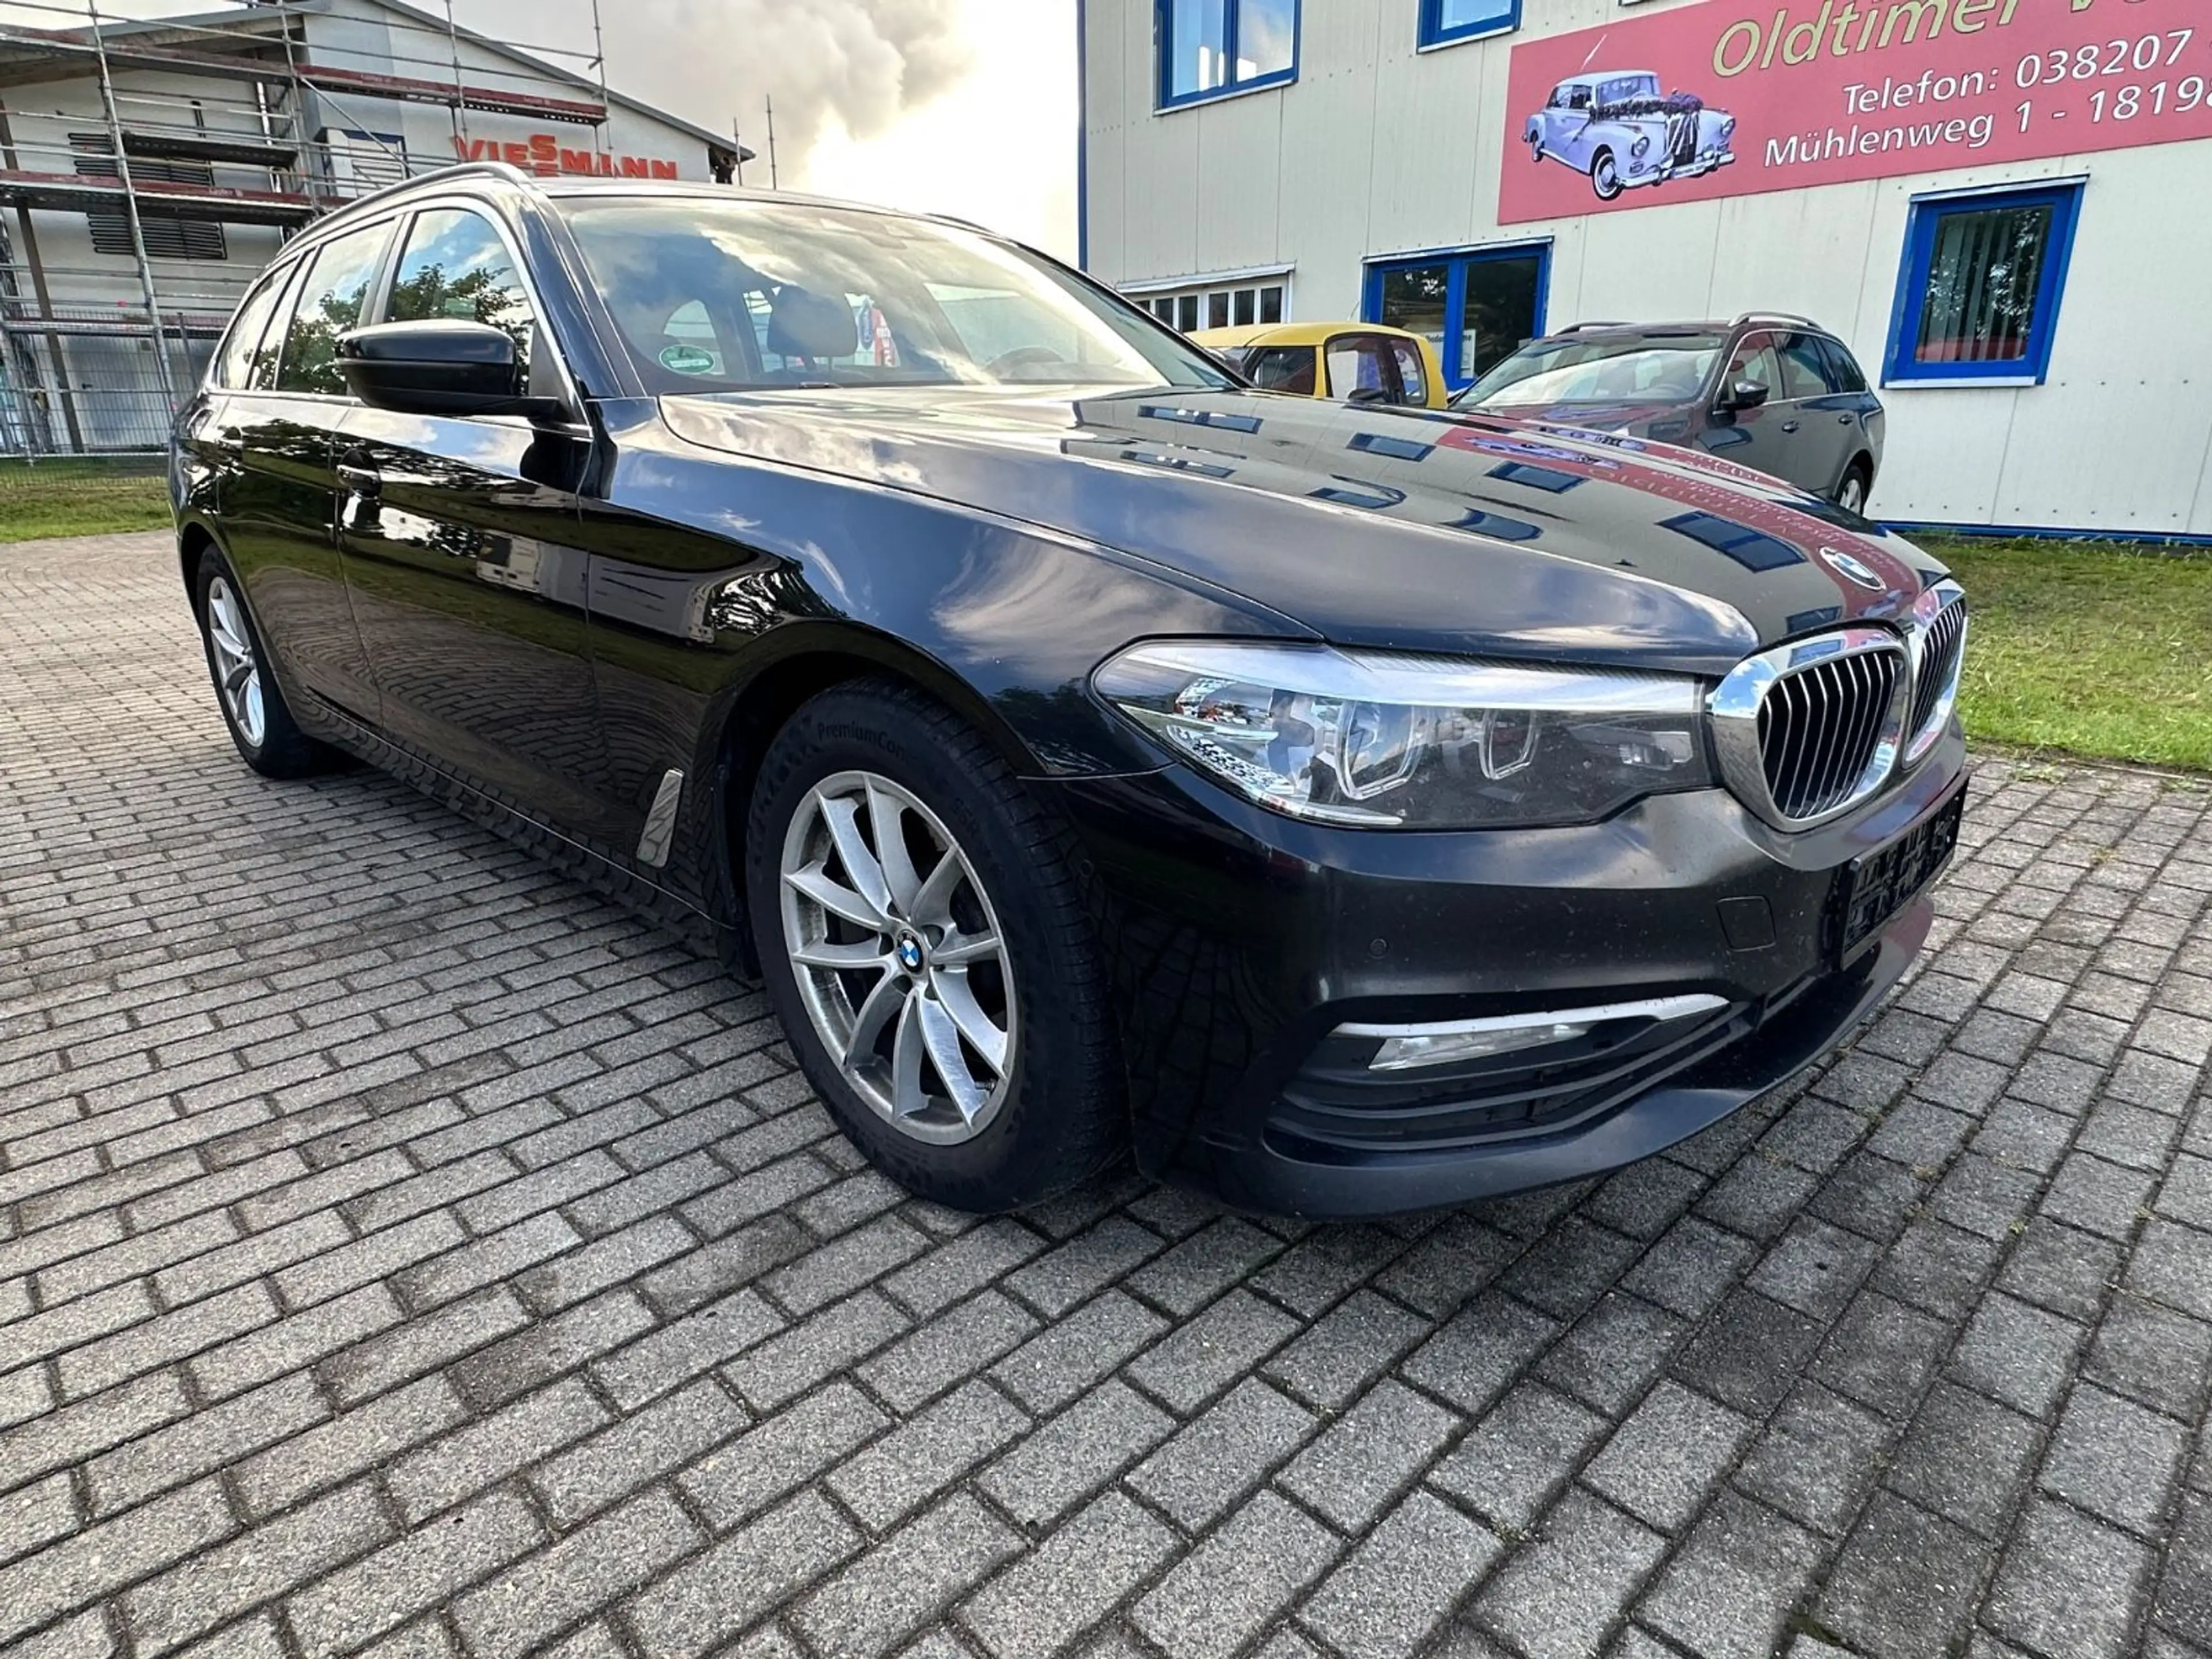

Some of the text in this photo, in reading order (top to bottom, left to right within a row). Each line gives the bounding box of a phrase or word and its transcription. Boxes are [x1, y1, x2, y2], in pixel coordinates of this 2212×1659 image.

[1842, 28, 2194, 115] Telefon: 038207
[1764, 75, 2212, 167] Mühlenweg 1 - 1819
